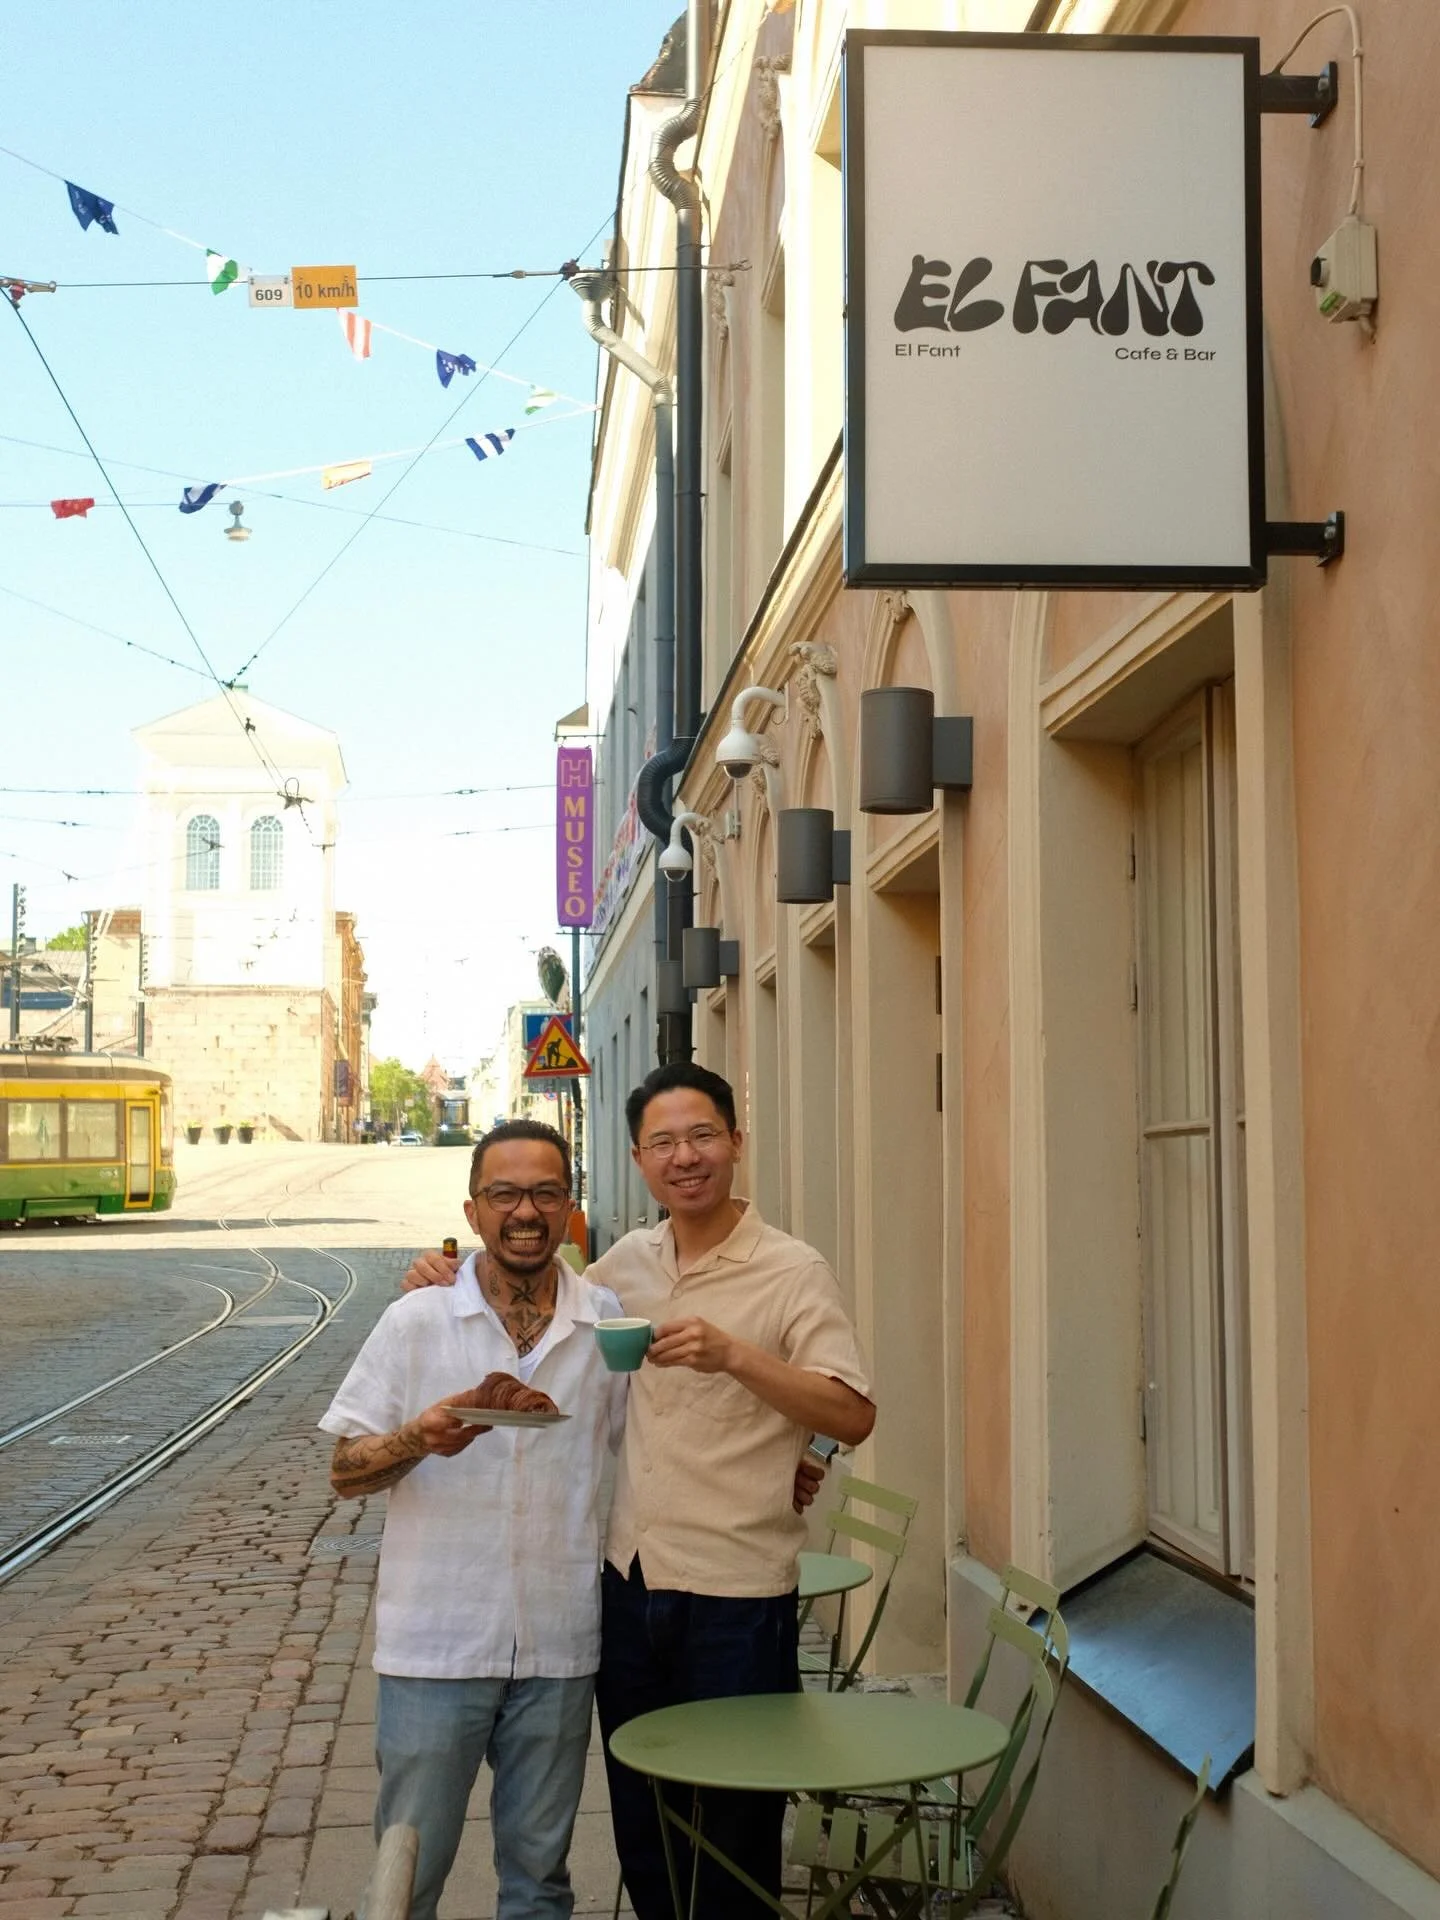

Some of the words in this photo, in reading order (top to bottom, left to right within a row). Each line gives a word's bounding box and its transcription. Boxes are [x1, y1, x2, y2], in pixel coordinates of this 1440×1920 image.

[255, 288, 283, 301] 609
[295, 283, 313, 299] 10
[317, 281, 356, 298] km/h
[894, 254, 1005, 333] EL
[1012, 259, 1216, 337] FANT
[895, 343, 912, 357] El
[917, 344, 961, 357] Fant
[1114, 346, 1162, 361] Cafe
[1166, 347, 1179, 361] &
[1183, 348, 1217, 361] Bar
[564, 795, 586, 918] MUSEO
